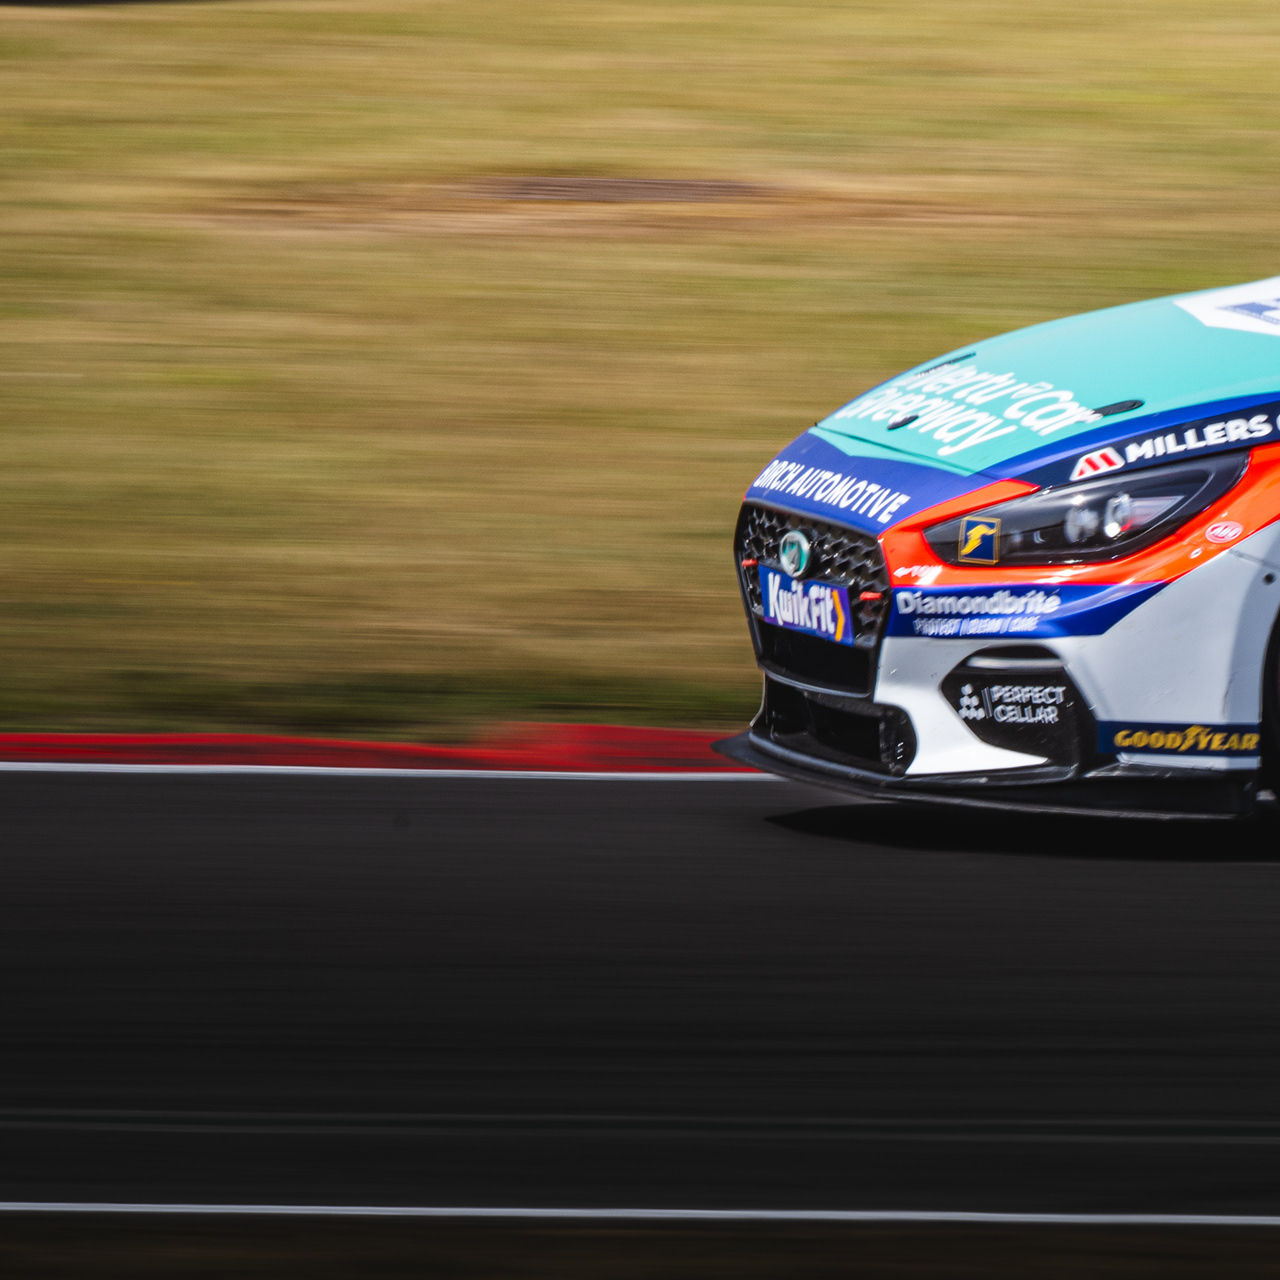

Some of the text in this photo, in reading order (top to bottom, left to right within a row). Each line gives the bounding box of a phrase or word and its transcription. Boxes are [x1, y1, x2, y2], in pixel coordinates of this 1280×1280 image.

[1124, 413, 1274, 464] MILLERS
[753, 460, 912, 524] BIRCH AUTOMOTIVE
[896, 588, 1062, 615] Diamondbrite
[991, 685, 1066, 705] PERFECT
[994, 705, 1060, 724] CELLAR
[1114, 725, 1261, 752] GOODYEAR
